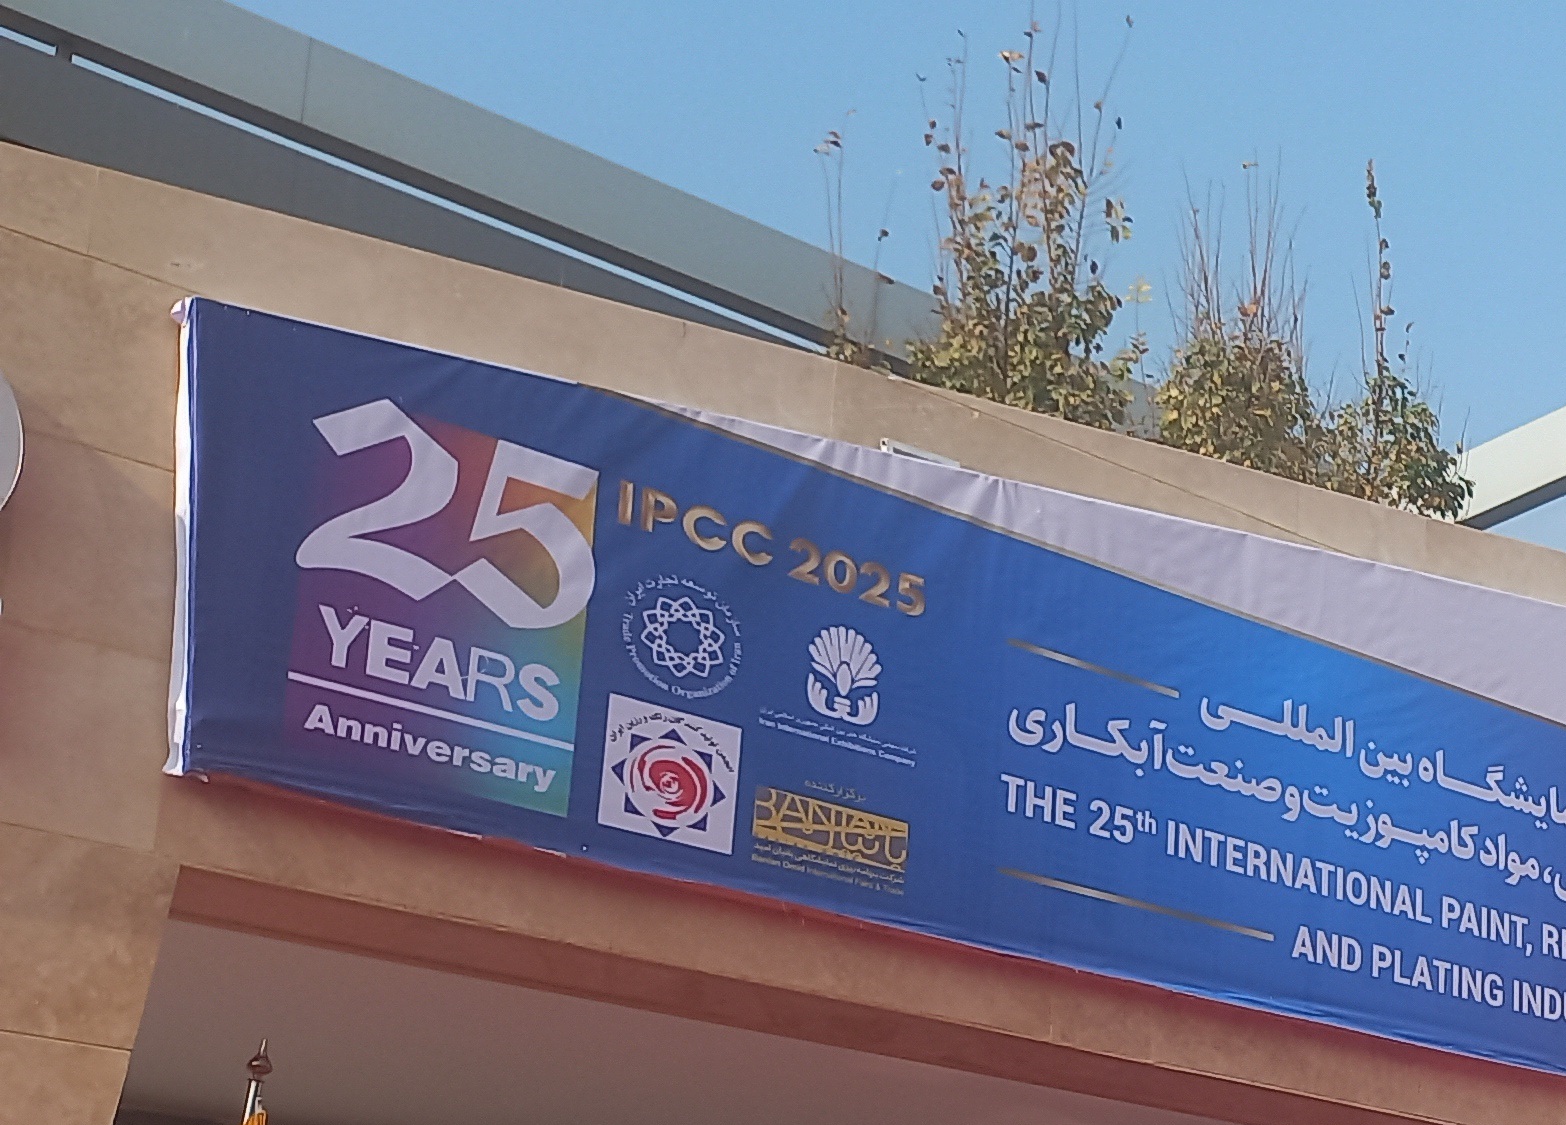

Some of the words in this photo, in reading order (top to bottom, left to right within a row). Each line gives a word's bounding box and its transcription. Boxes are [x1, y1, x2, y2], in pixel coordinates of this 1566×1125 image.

[295, 398, 600, 629] 25
[617, 479, 774, 566] IPCC
[788, 537, 926, 617] 2025
[318, 603, 560, 721] YEARS
[304, 704, 556, 792] Anniversary
[1008, 702, 1167, 777] آبکاری
[1200, 697, 1356, 758] المللی
[1359, 741, 1414, 787] بین
[1164, 742, 1283, 803] صنعت
[1282, 784, 1302, 820] و
[1302, 786, 1479, 864] کامپوزیت
[1479, 834, 1540, 885] مواد
[1000, 773, 1077, 829] THE
[1089, 799, 1157, 843] 25th
[1166, 819, 1432, 925] INTERNATIONAL
[1441, 895, 1533, 957] PAINT,
[1291, 925, 1363, 972] AND
[1370, 948, 1504, 1007] PLATING
